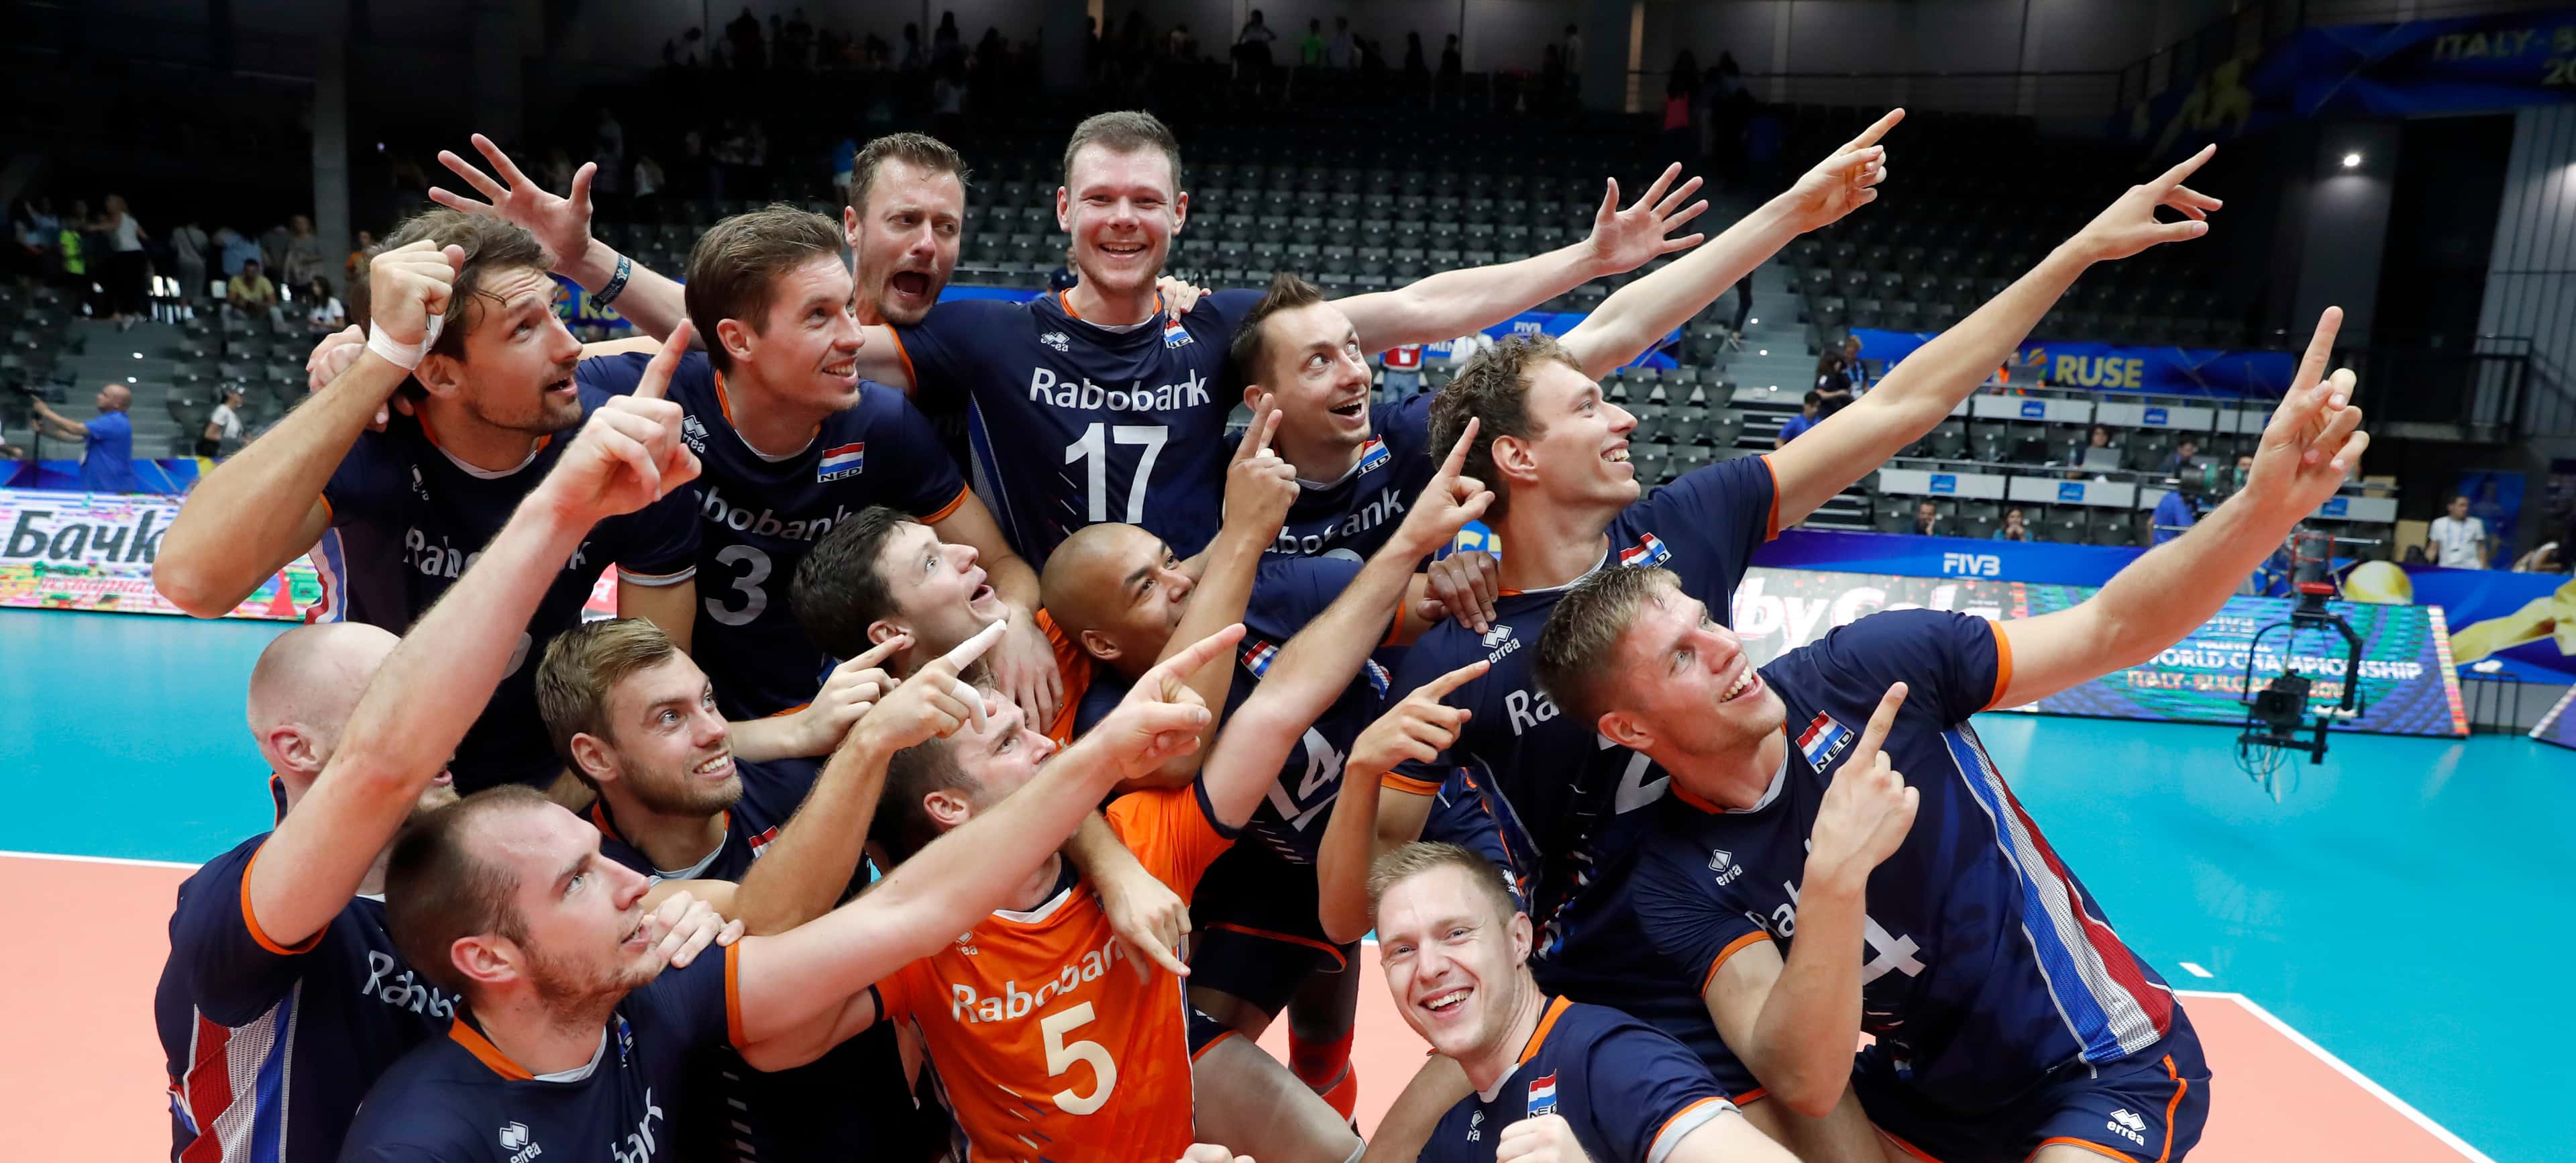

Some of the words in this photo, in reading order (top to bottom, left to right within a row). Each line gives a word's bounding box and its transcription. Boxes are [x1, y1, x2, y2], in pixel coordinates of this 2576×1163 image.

[1030, 367, 1210, 411] Rabobank
[2054, 354, 2145, 389] RUSE
[820, 468, 861, 482] NED
[1065, 422, 1169, 523] 17
[705, 544, 772, 626] 3
[1489, 638, 1521, 664] errea
[1817, 731, 1852, 771] NED
[952, 935, 1124, 1023] Raboban
[1040, 1001, 1117, 1115] 5
[510, 1142, 543, 1163] errea
[2107, 1121, 2145, 1146] errea
